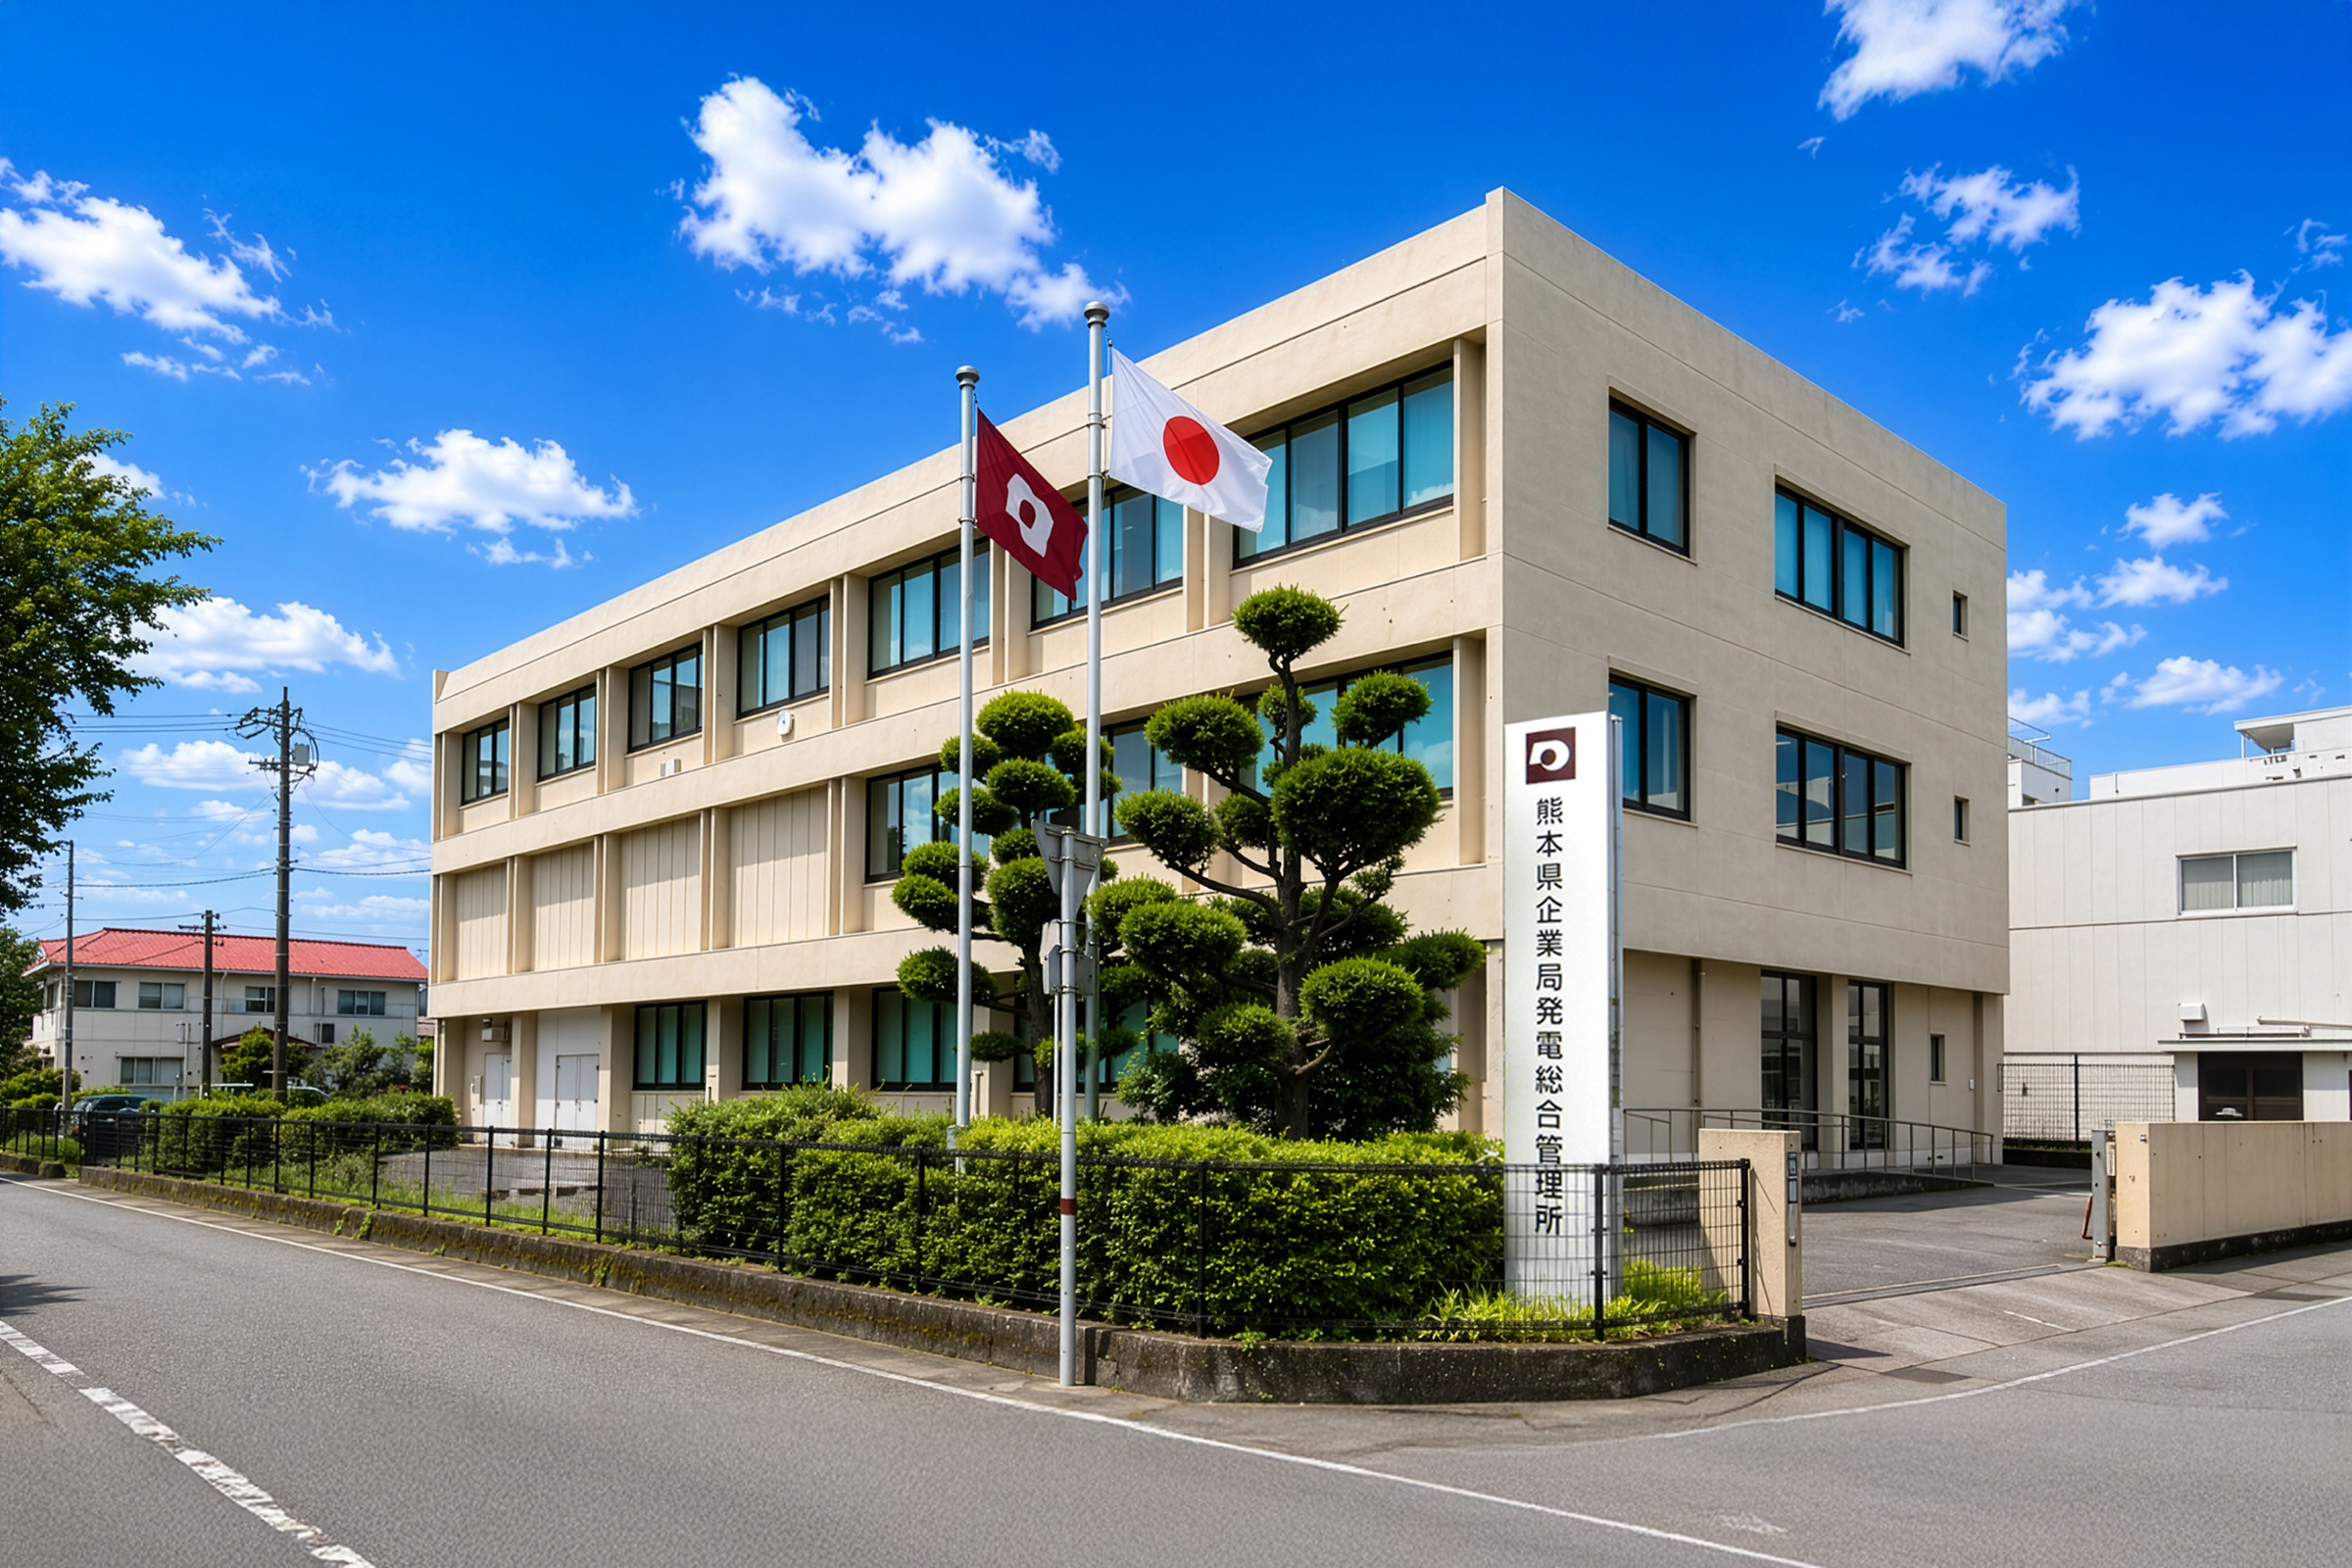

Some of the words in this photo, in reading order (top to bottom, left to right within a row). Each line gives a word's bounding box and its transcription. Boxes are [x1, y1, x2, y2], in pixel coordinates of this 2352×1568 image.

[1535, 797, 1563, 1235] 熊本県企業局発電総合管理所
